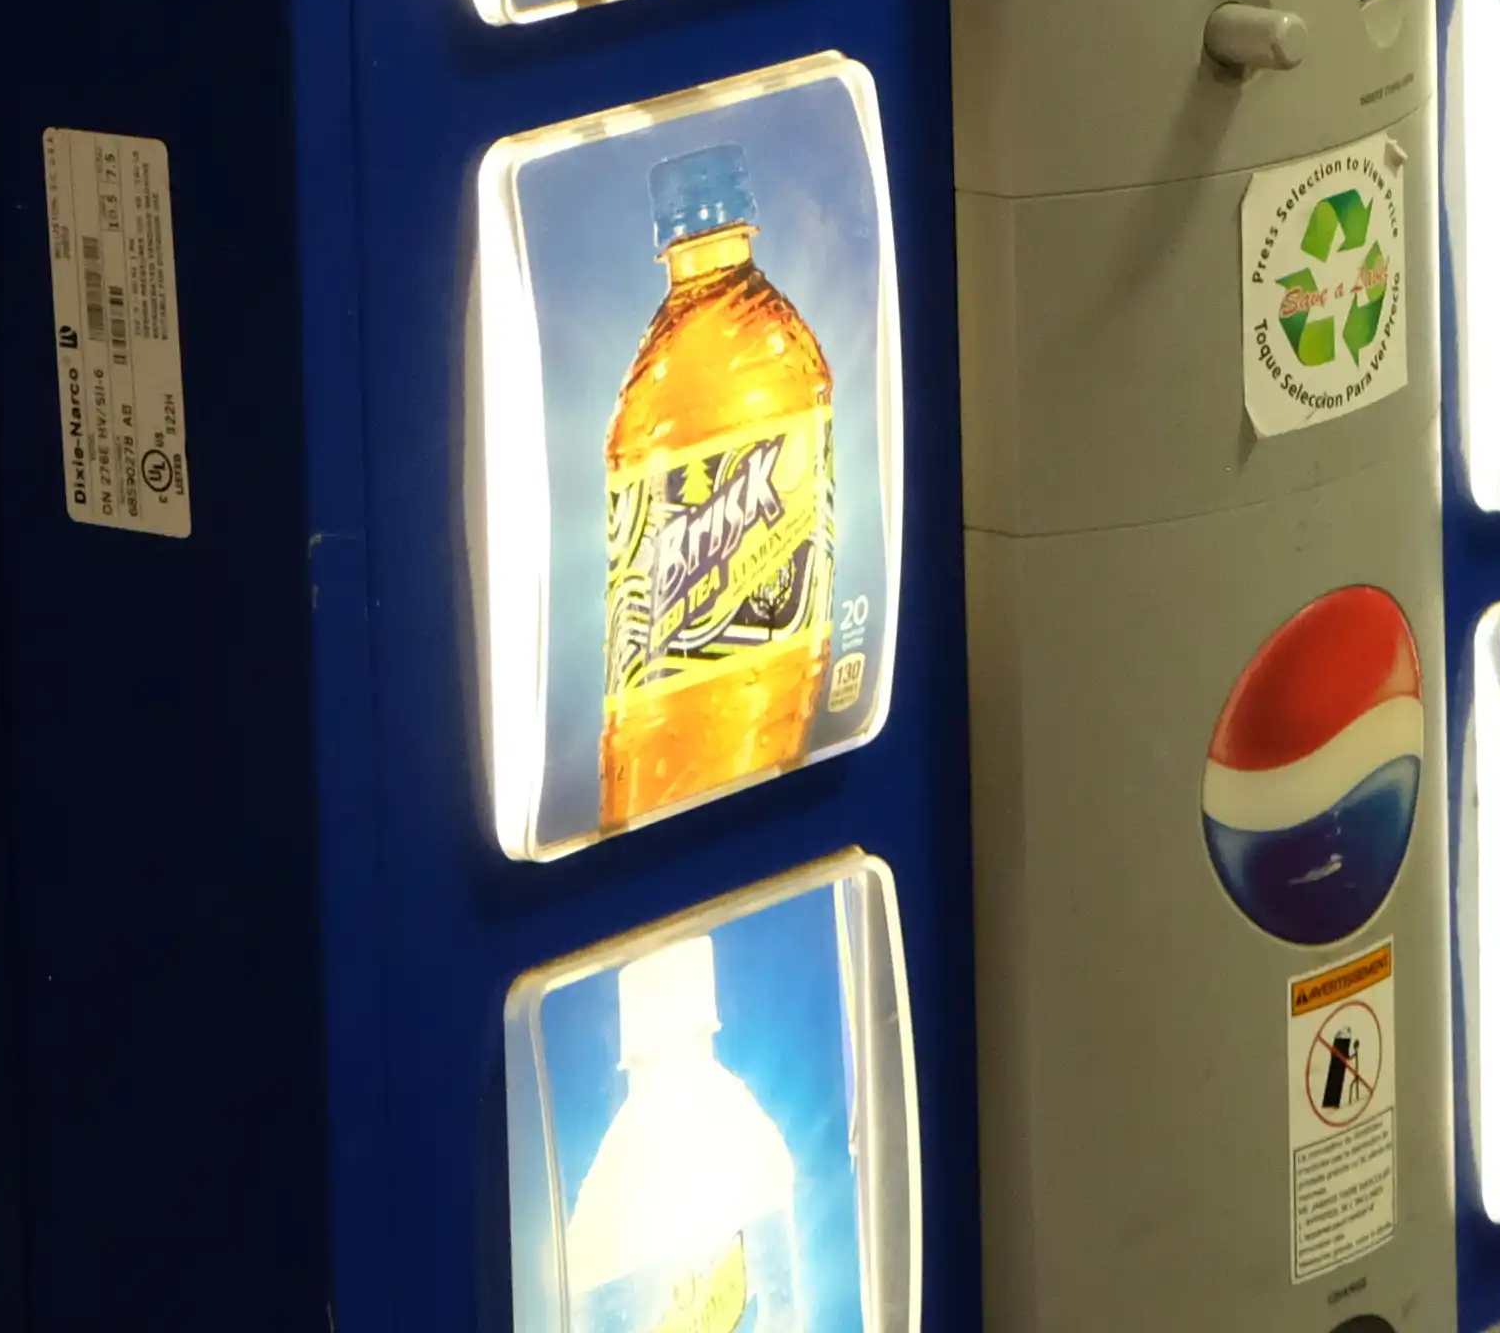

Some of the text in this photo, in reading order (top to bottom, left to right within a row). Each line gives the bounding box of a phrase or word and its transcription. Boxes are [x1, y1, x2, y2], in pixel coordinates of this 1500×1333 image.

[104, 153, 116, 177] 7.5
[1252, 156, 1399, 284] Press Selection to View Price
[1280, 287, 1329, 318] Save
[1333, 283, 1344, 299] a
[1252, 272, 1401, 410] Toque Seleccion Para Ver Precio
[68, 367, 87, 505] Dixie-Narco
[101, 491, 113, 516] DN
[688, 565, 721, 613] TEA
[840, 595, 869, 631] 20
[836, 659, 861, 685] 130
